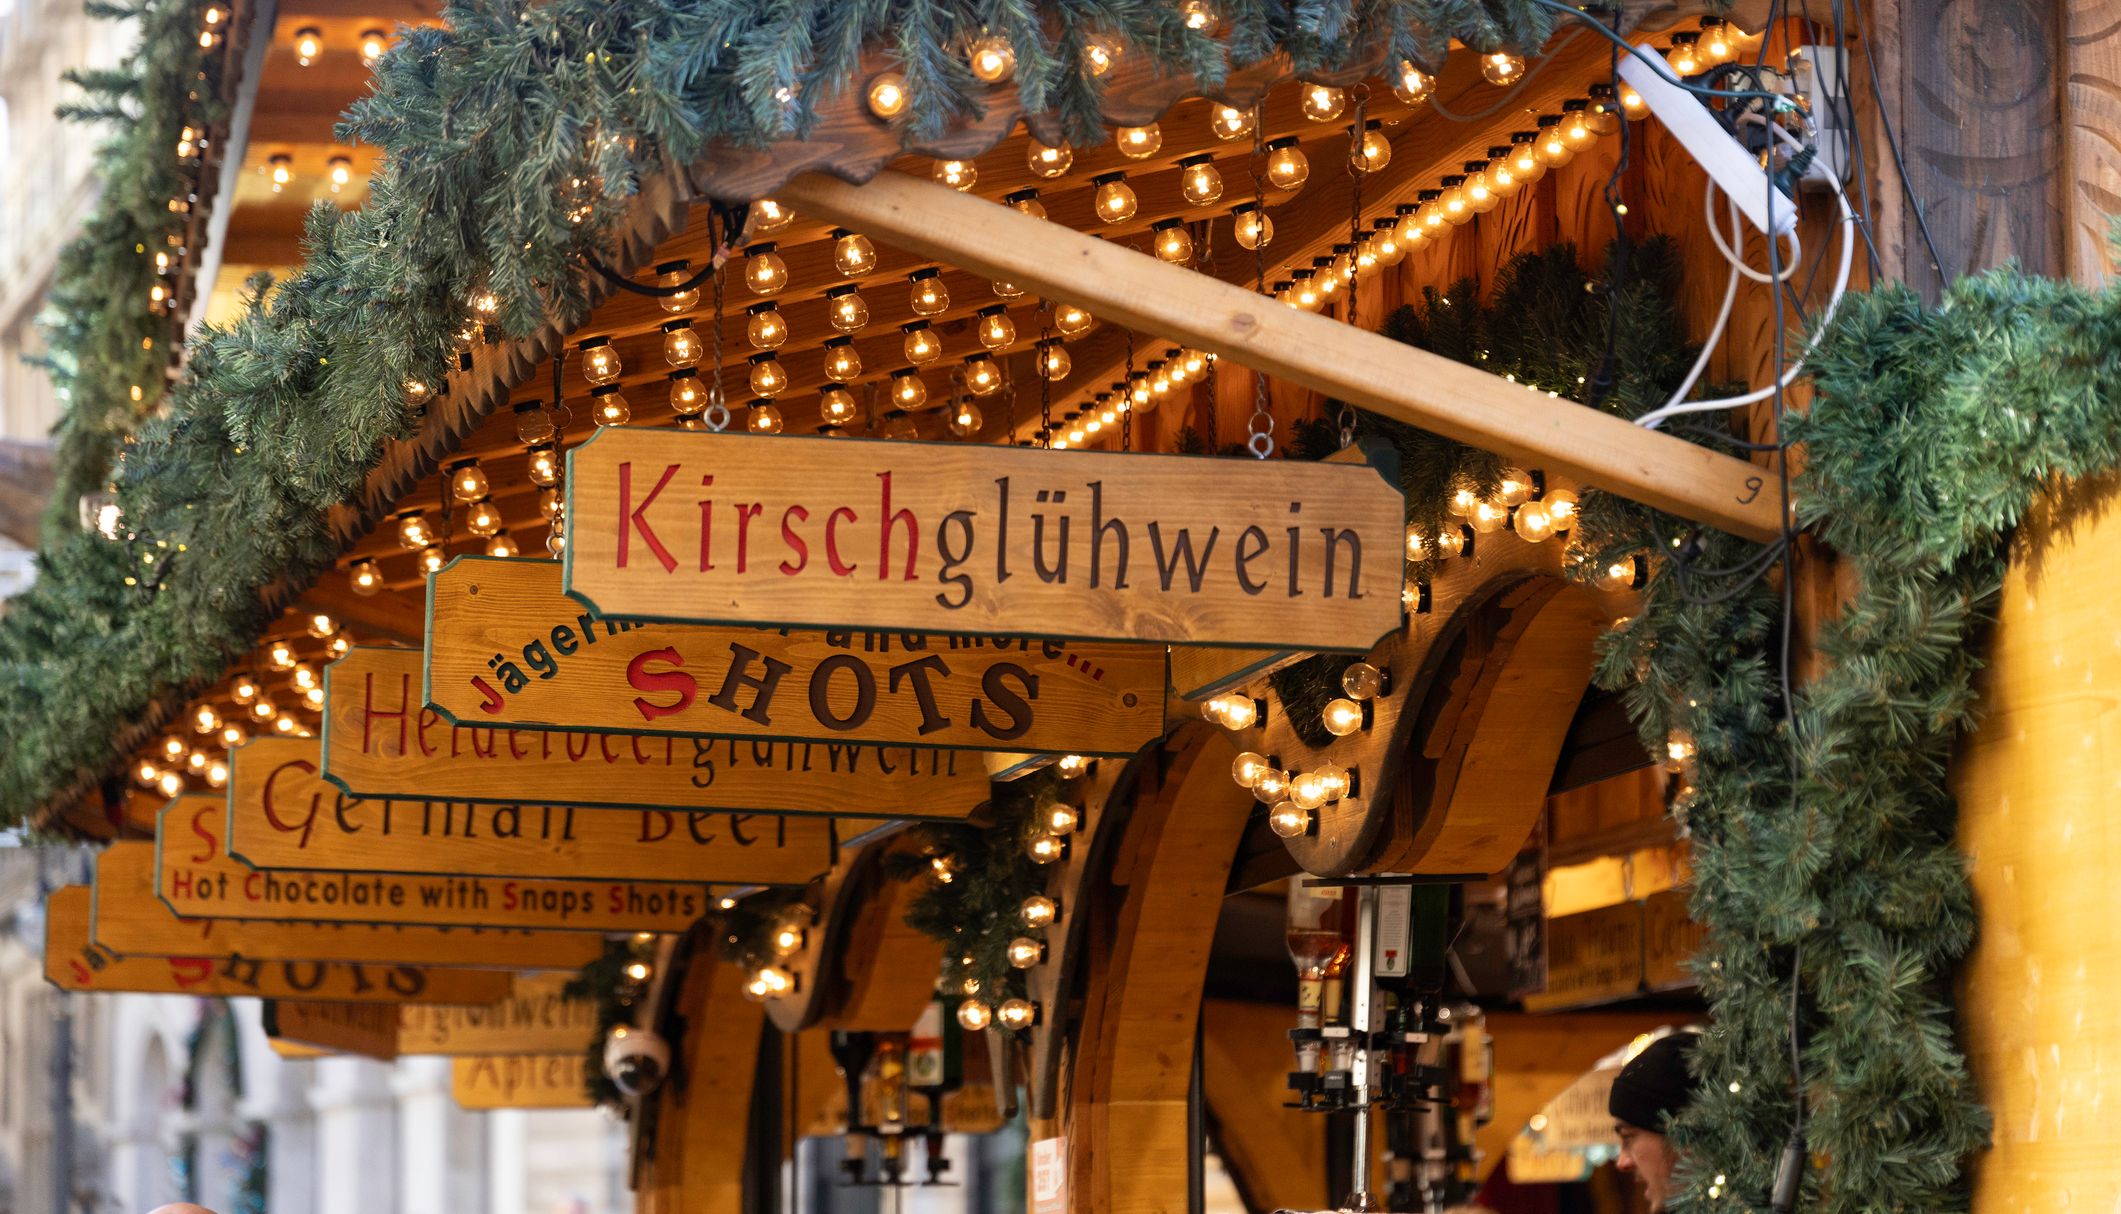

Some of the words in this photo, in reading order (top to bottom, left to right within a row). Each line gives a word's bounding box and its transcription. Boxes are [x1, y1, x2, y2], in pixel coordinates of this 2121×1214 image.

[616, 461, 1364, 610] Kirschglühwein
[625, 641, 1041, 741] SHOTS
[173, 869, 228, 900] Hot
[244, 872, 405, 906] Chocolate
[420, 877, 490, 911] with
[503, 882, 595, 919] Snaps
[608, 884, 696, 917] Shots
